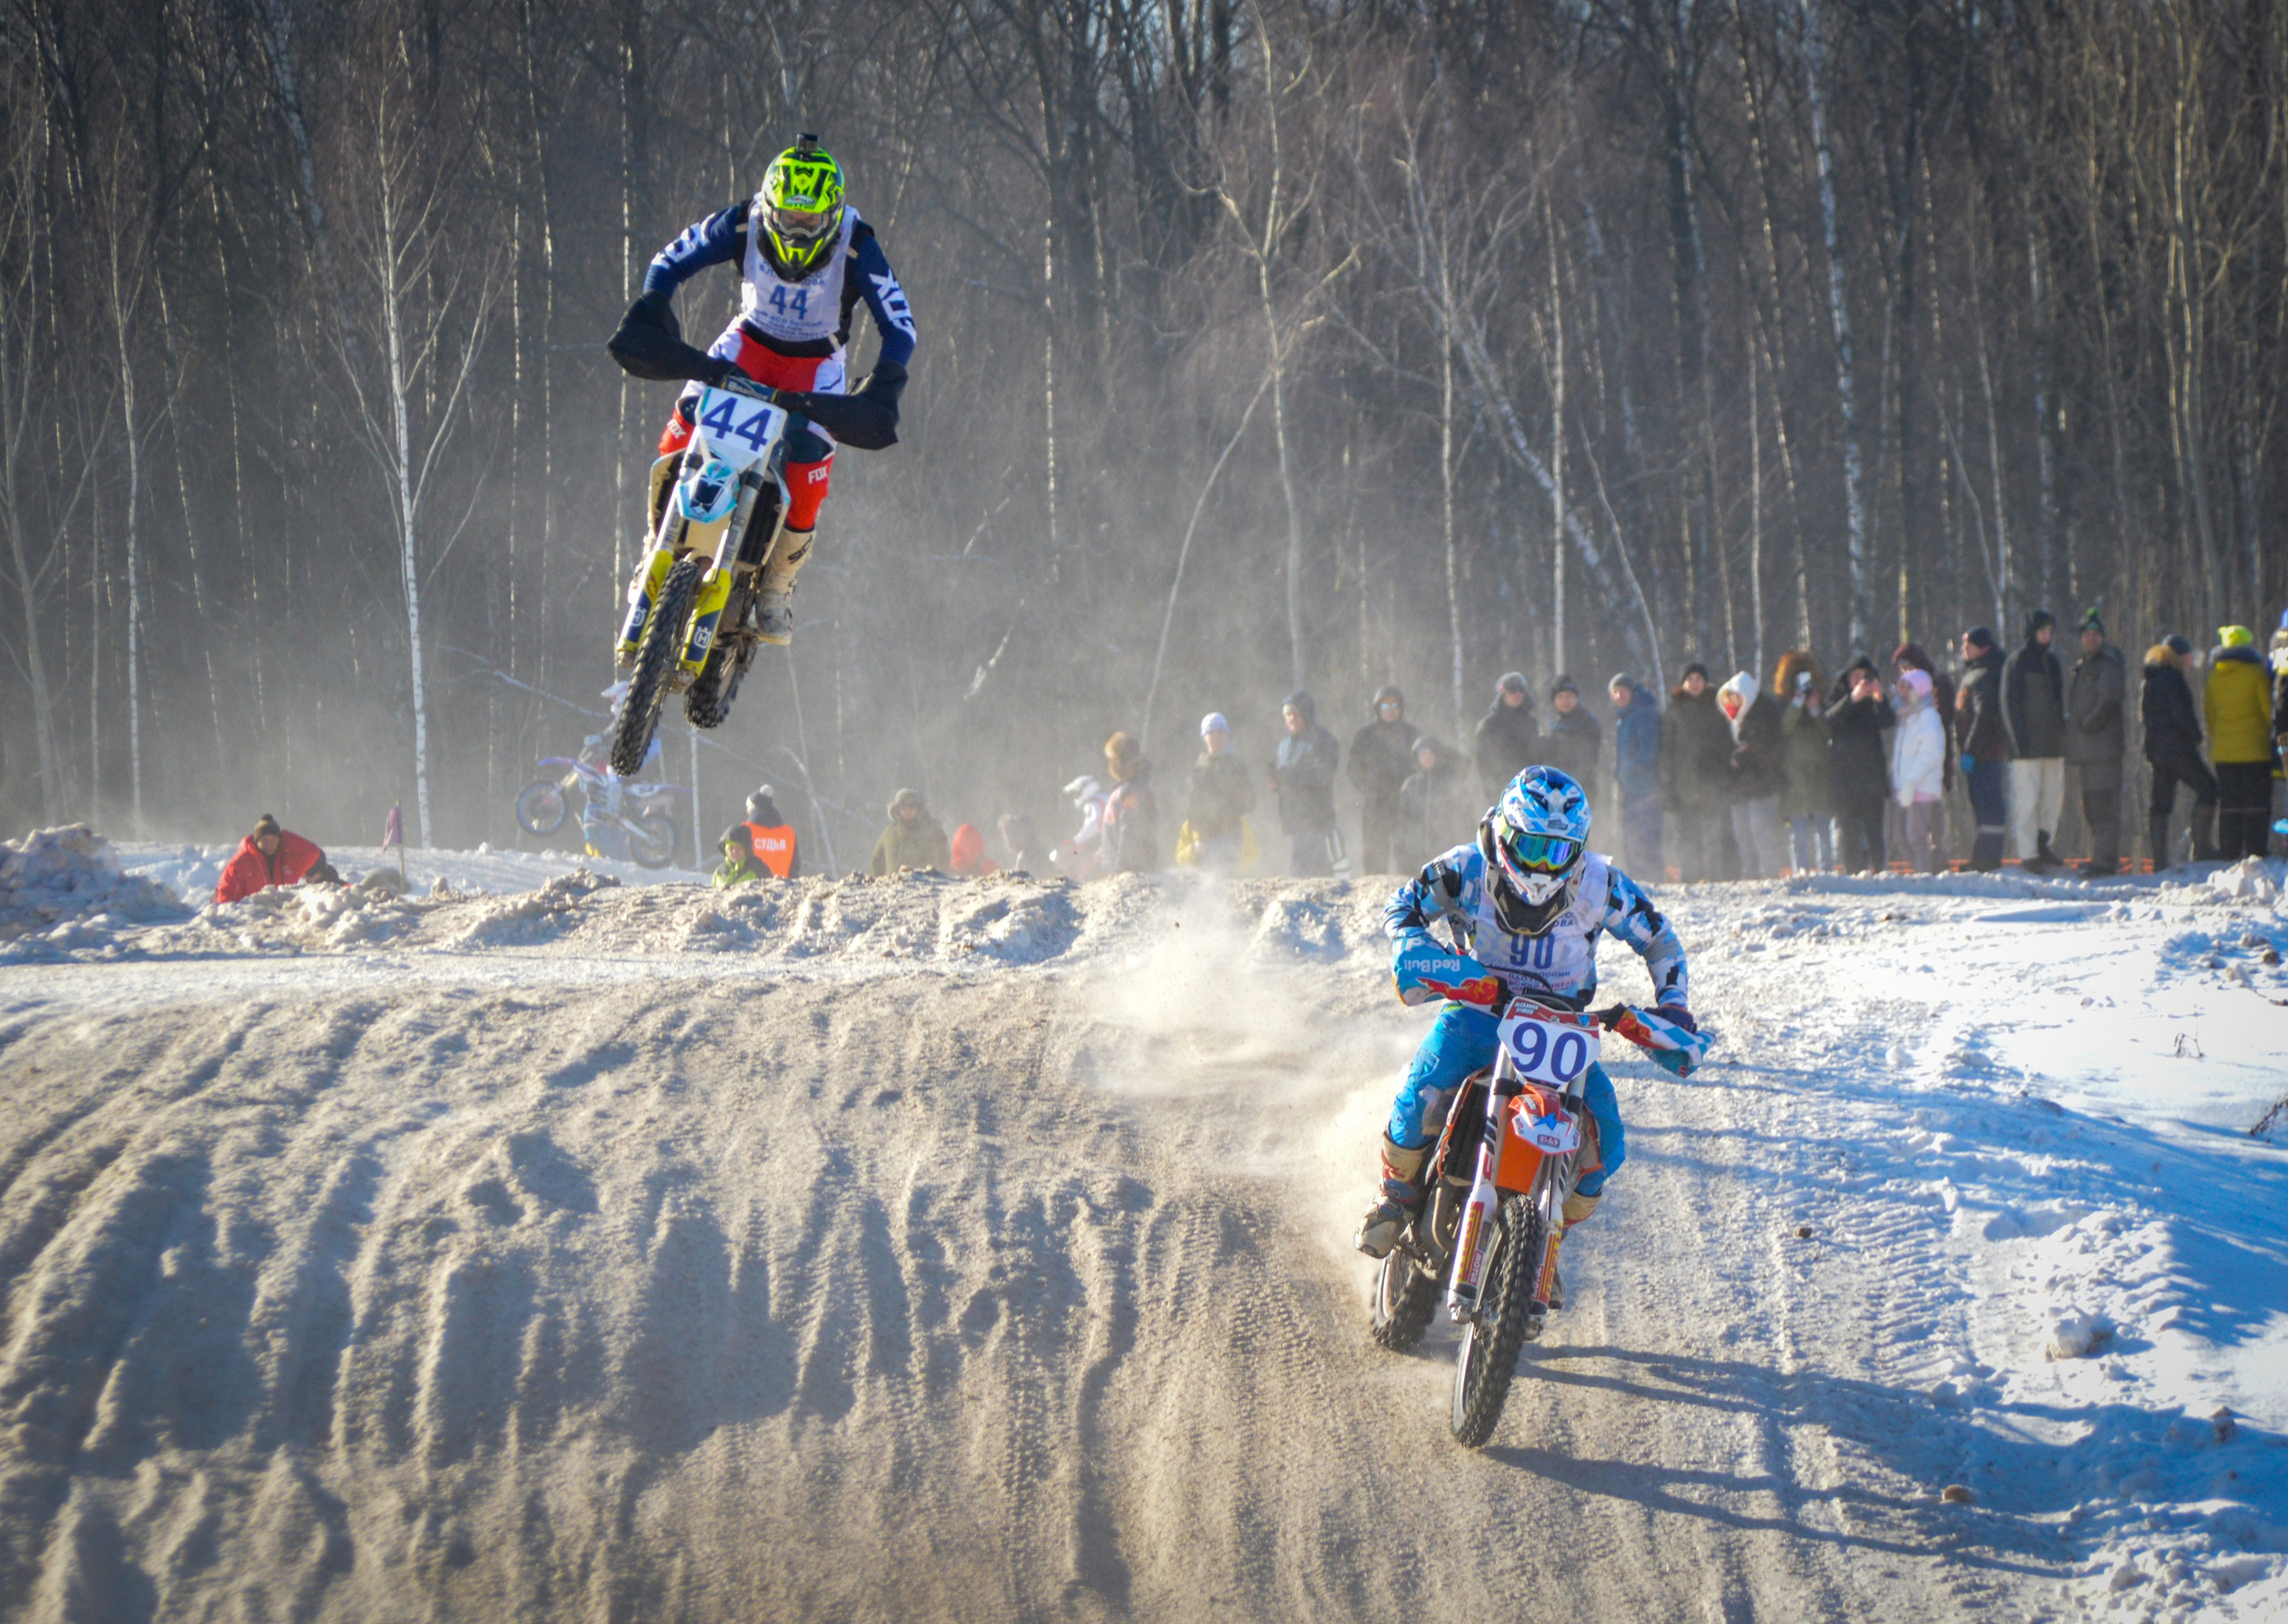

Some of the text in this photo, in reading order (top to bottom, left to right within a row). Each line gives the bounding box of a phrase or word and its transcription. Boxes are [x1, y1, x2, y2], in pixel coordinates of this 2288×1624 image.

[770, 284, 808, 320] 44
[701, 396, 772, 452] 44
[808, 465, 828, 484] FOX
[1510, 932, 1555, 970] 90
[1511, 1022, 1587, 1083] 90
[1468, 1250, 1484, 1285] MOTUL
